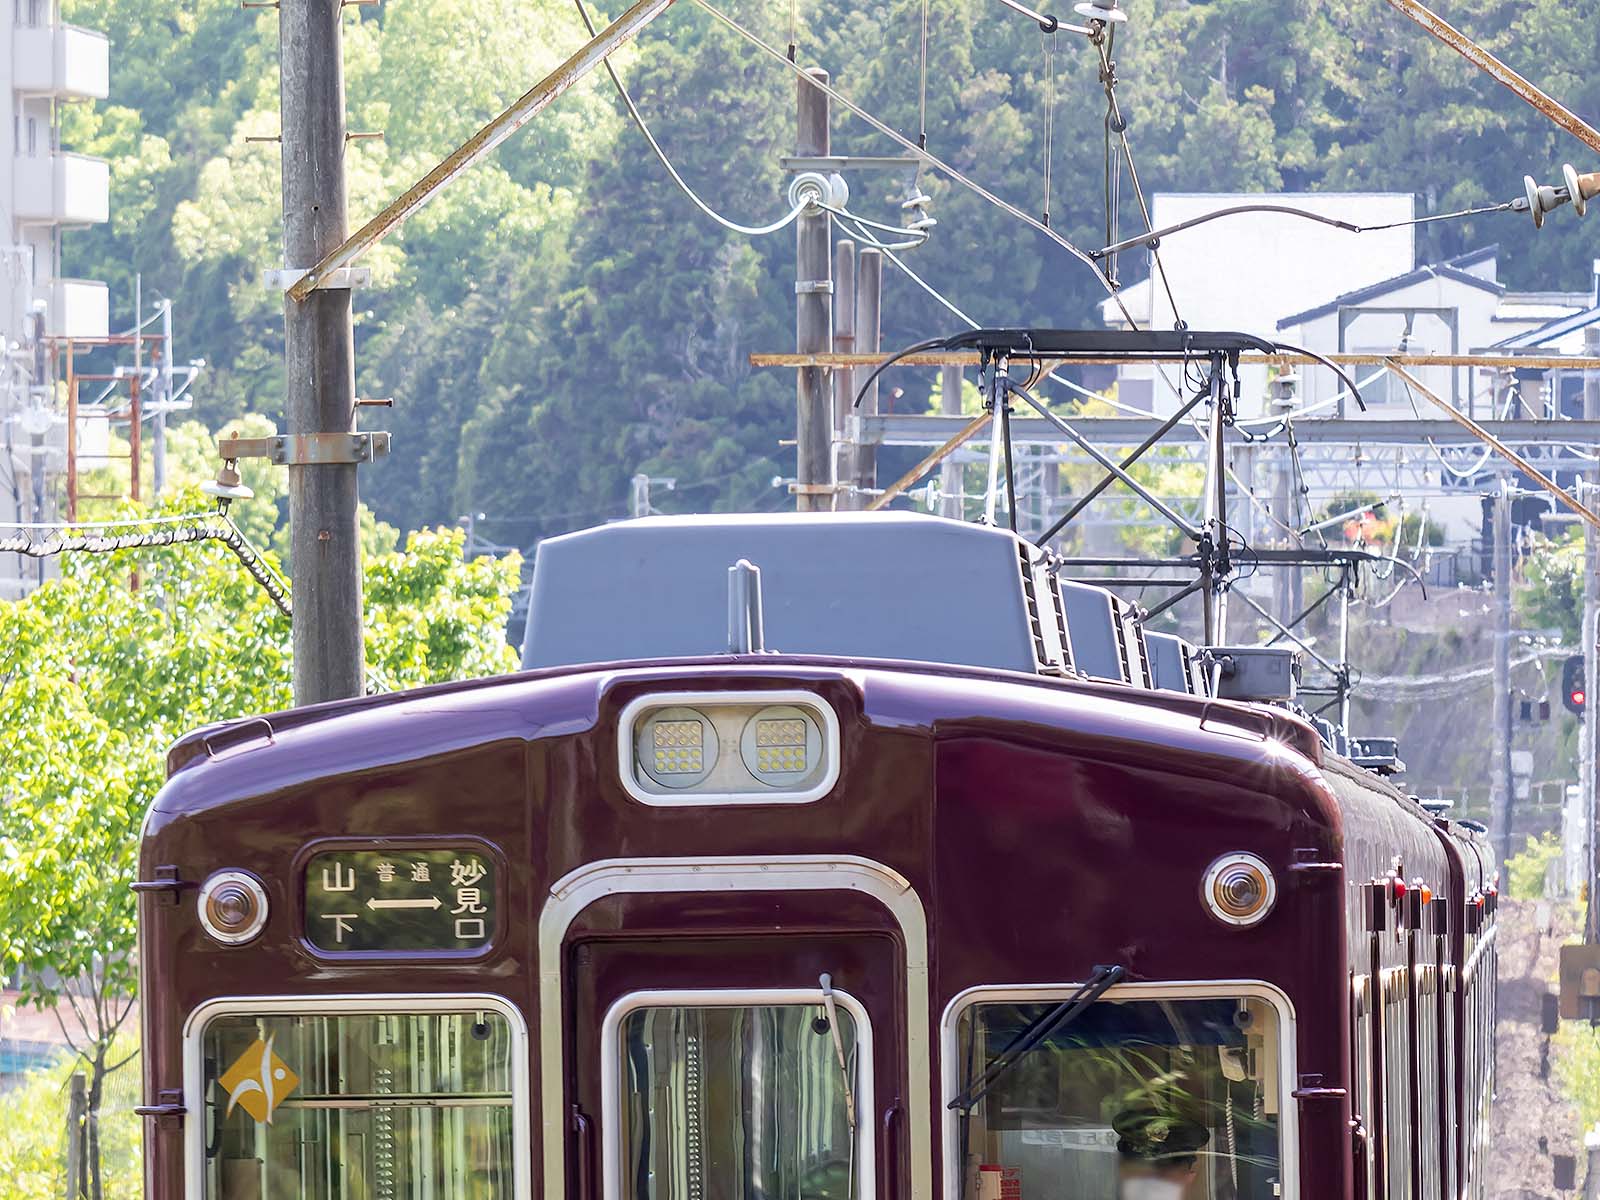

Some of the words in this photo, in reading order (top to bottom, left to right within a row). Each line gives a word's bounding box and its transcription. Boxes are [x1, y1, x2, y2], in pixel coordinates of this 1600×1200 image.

[321, 862, 358, 943] 山下
[376, 862, 431, 882] 普通
[450, 859, 487, 939] 妙見口
